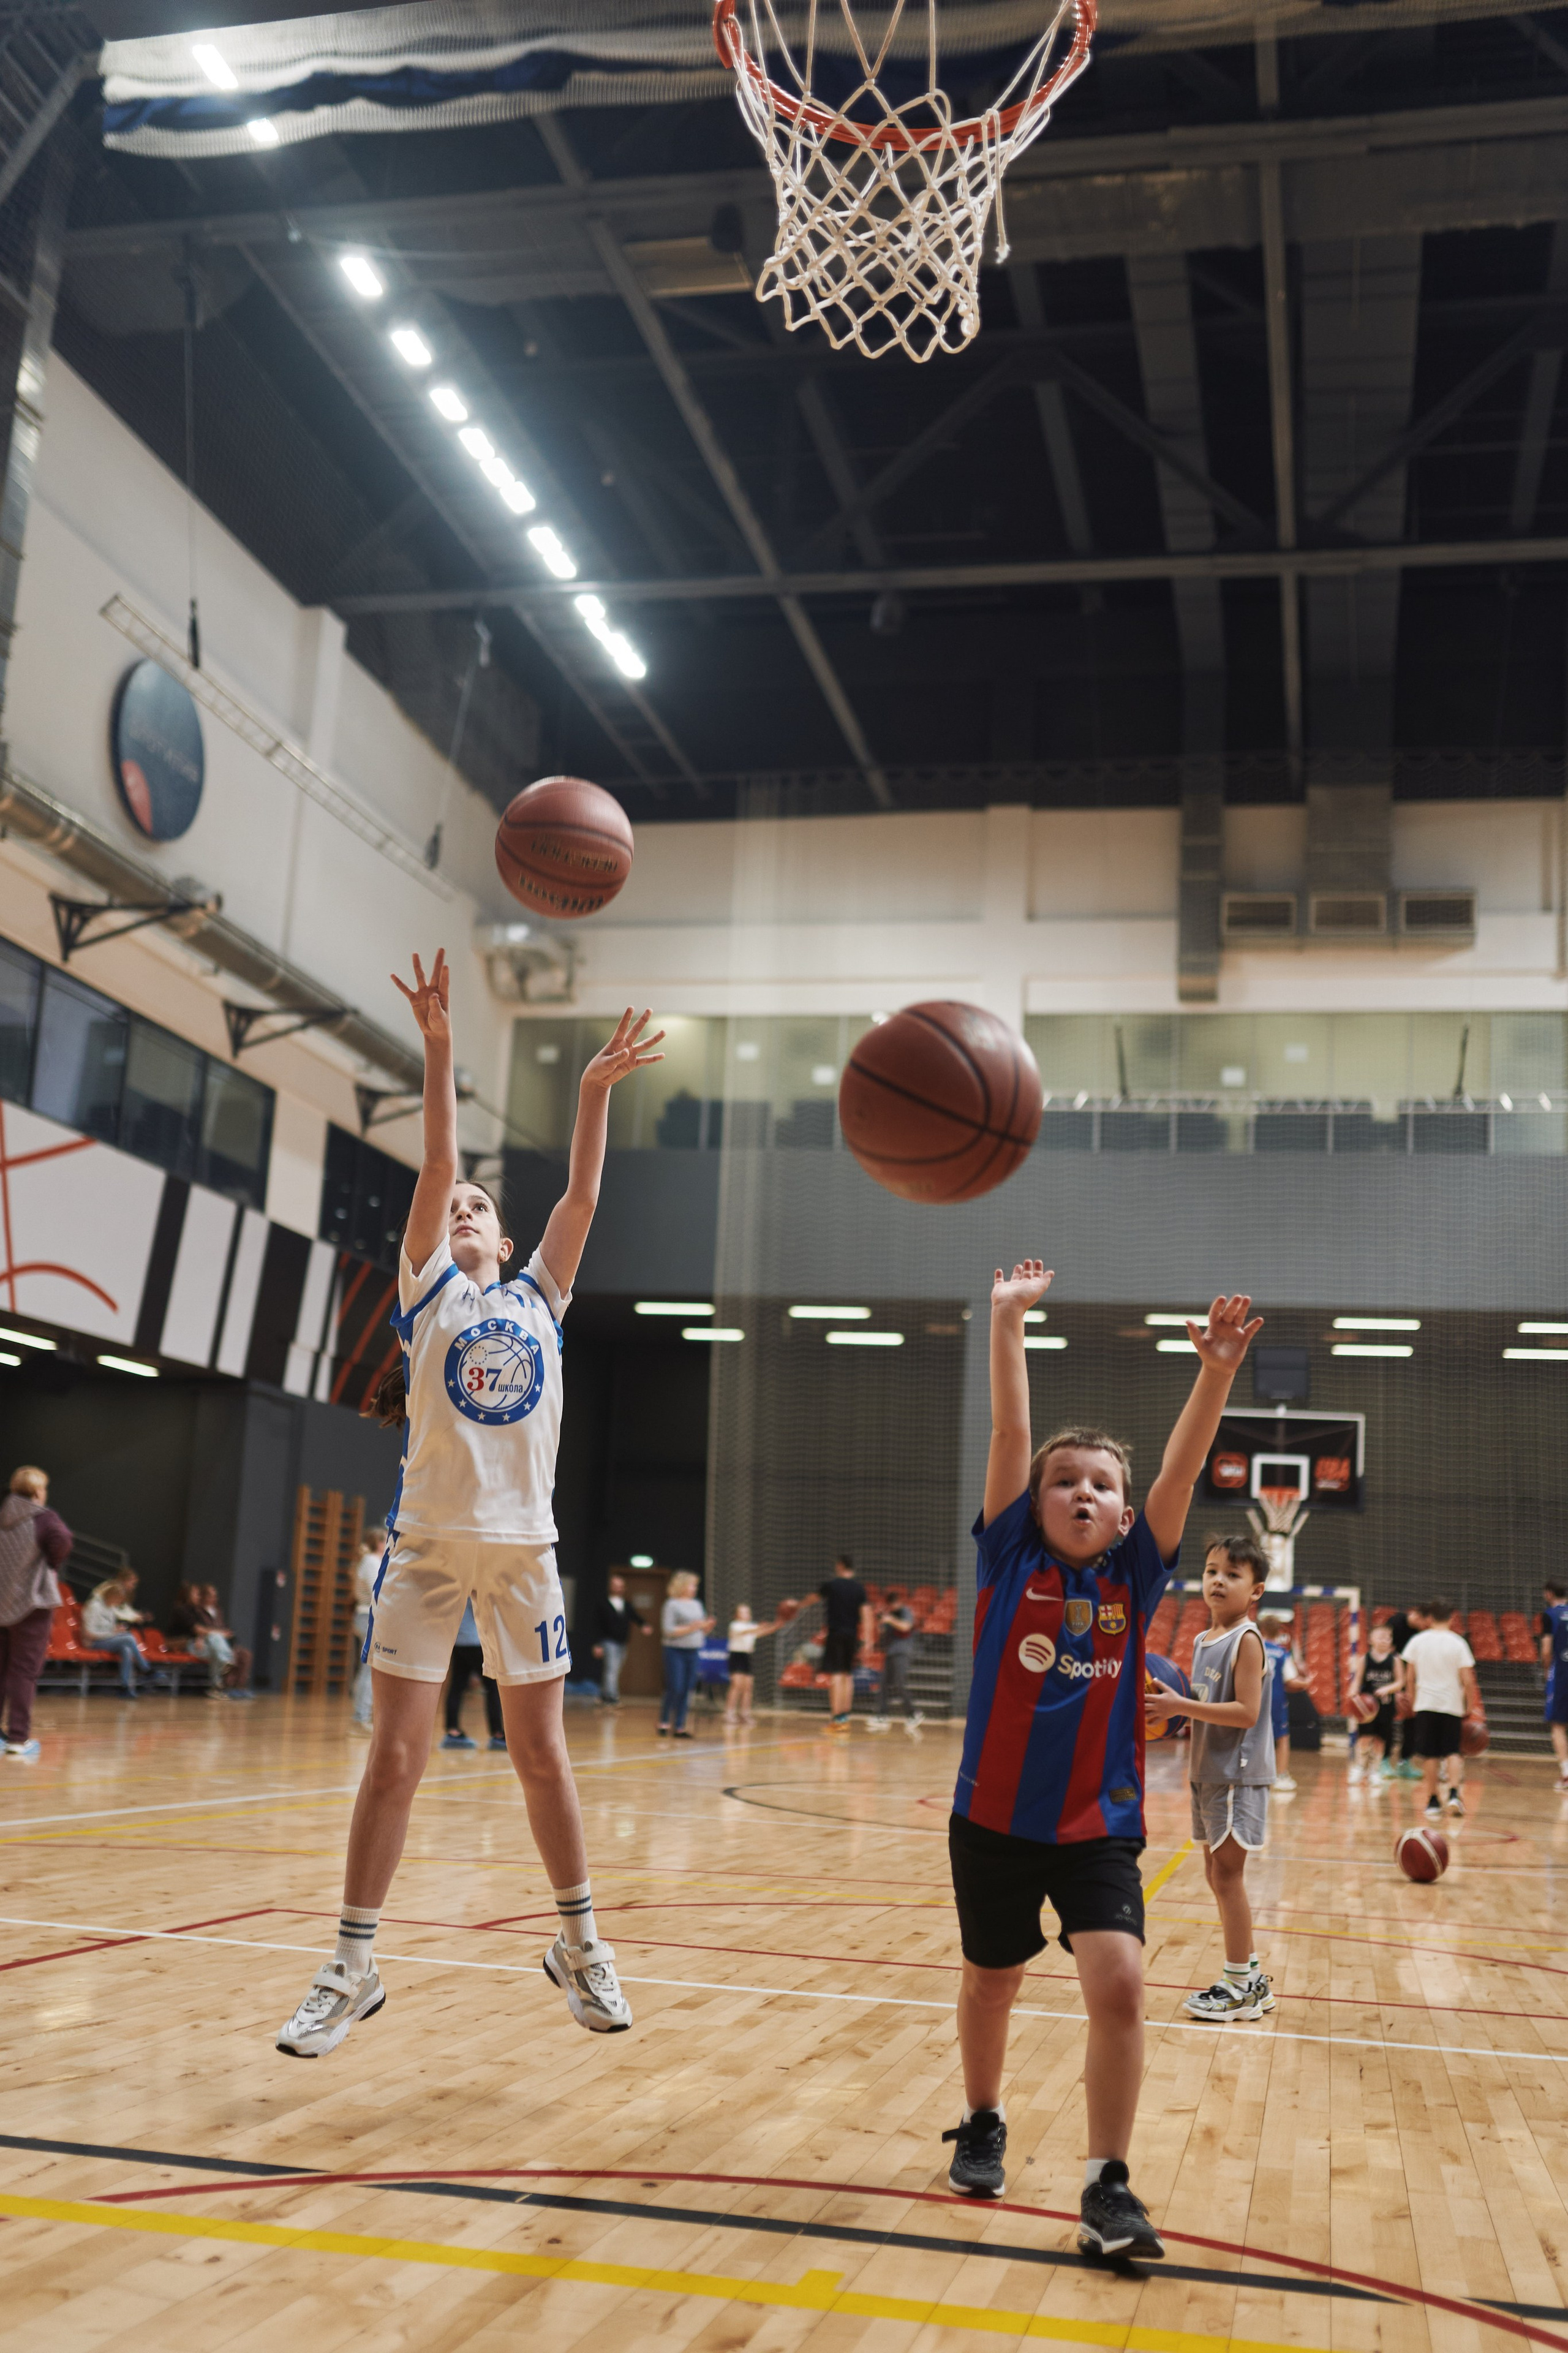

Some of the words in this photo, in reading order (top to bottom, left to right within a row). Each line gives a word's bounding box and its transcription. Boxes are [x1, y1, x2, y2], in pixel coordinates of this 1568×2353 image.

[454, 1320, 539, 1355] МОСКВА
[467, 1367, 502, 1392] 37
[498, 1383, 523, 1393] школа
[382, 1647, 397, 1655] SPORT
[534, 1614, 567, 1663] 12
[1057, 1654, 1122, 1680] Spotify
